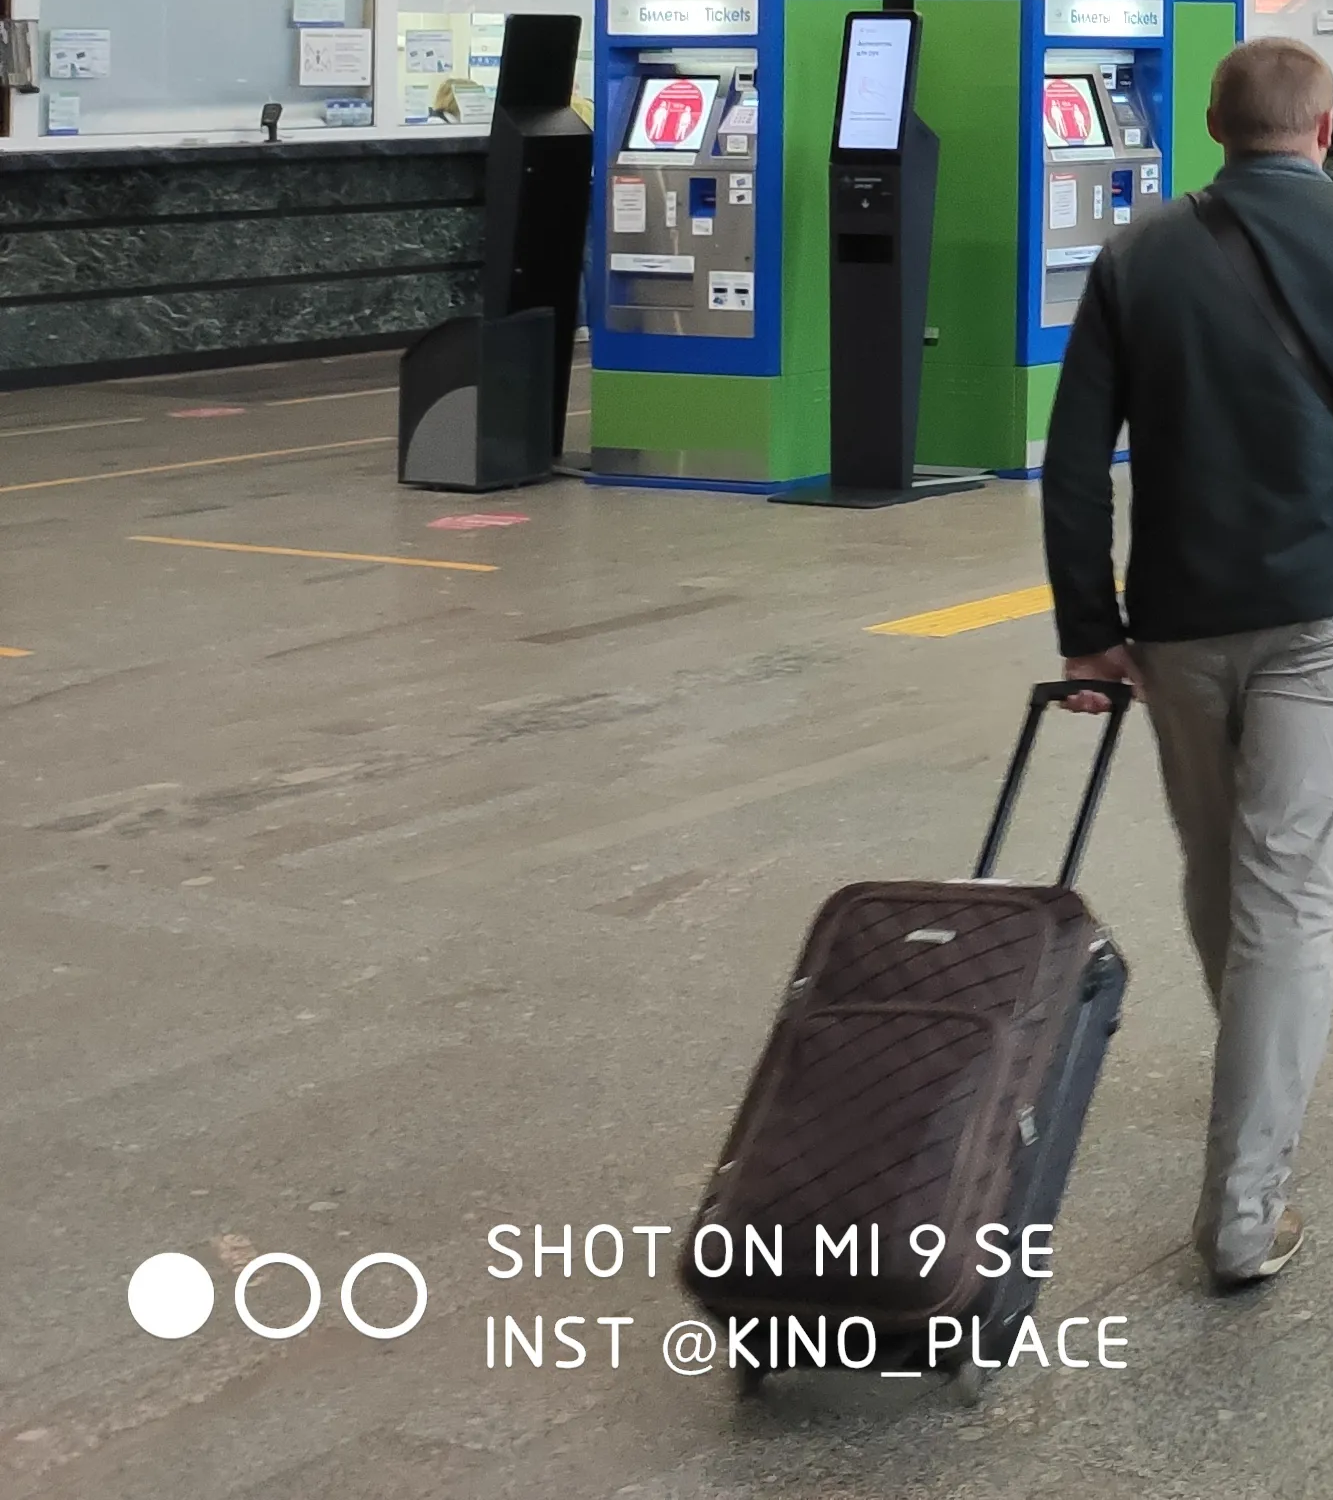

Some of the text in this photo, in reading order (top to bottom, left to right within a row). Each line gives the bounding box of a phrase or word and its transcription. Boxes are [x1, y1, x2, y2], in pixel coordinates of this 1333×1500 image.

[639, 6, 689, 22] Билеты
[704, 6, 751, 22] Tickets
[1070, 8, 1111, 24] Билеты
[1123, 9, 1158, 25] Tickets
